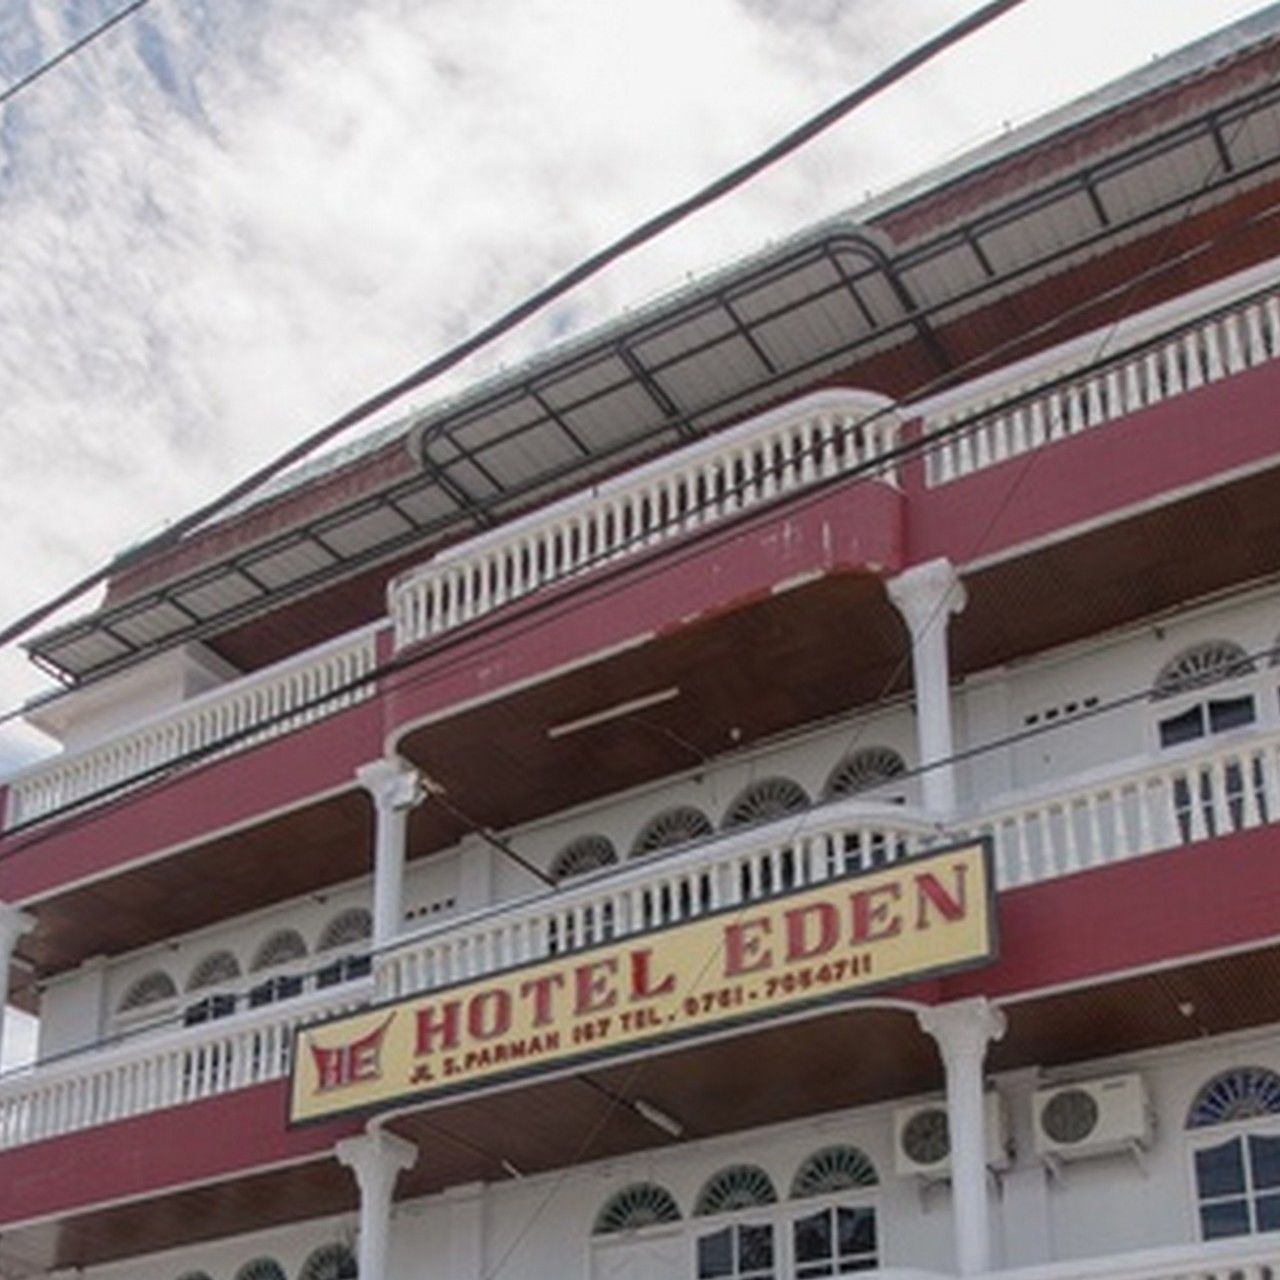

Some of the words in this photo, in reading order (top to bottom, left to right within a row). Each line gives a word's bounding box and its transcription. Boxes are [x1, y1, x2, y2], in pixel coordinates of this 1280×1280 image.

[412, 949, 676, 1058] HOTEL
[723, 864, 968, 978] EDEN
[573, 1020, 611, 1044] 167
